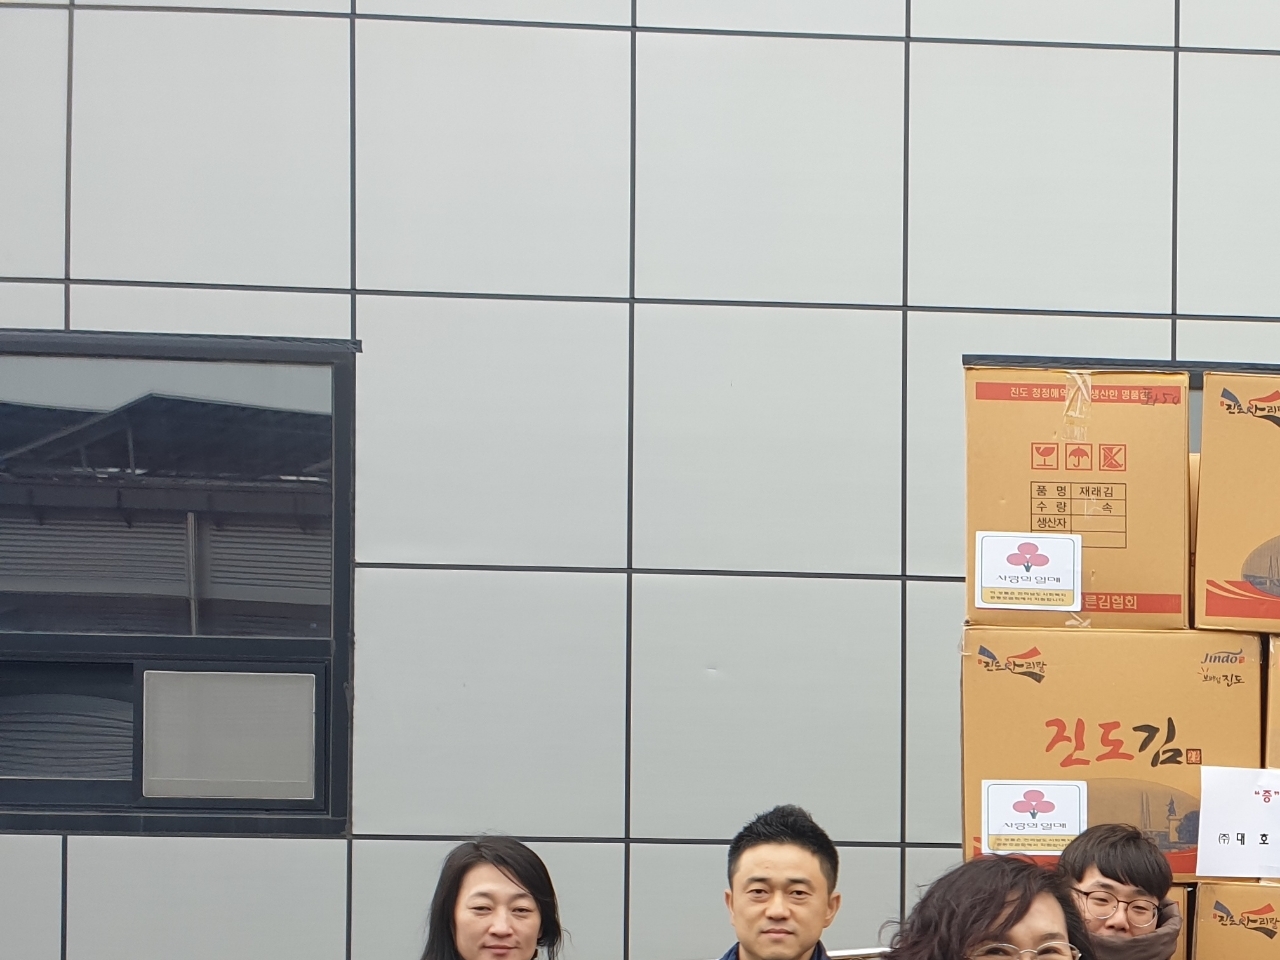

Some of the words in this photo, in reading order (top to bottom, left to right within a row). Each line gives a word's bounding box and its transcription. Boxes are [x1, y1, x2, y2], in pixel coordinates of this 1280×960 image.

[1010, 387, 1028, 398] 진도
[1036, 485, 1047, 496] 품
[1056, 485, 1067, 497] 명
[1079, 485, 1114, 498] 재래김
[1036, 501, 1047, 512] 수
[1056, 501, 1067, 513] 량
[1101, 502, 1113, 513] 속
[1036, 516, 1067, 529] 생산자
[995, 575, 1032, 584] 사랑의
[1082, 595, 1138, 610] 른김협회
[1200, 651, 1239, 665] Jindo
[1222, 673, 1246, 687] 진도
[1044, 716, 1184, 768] 진도김
[1003, 822, 1038, 831] 사랑의
